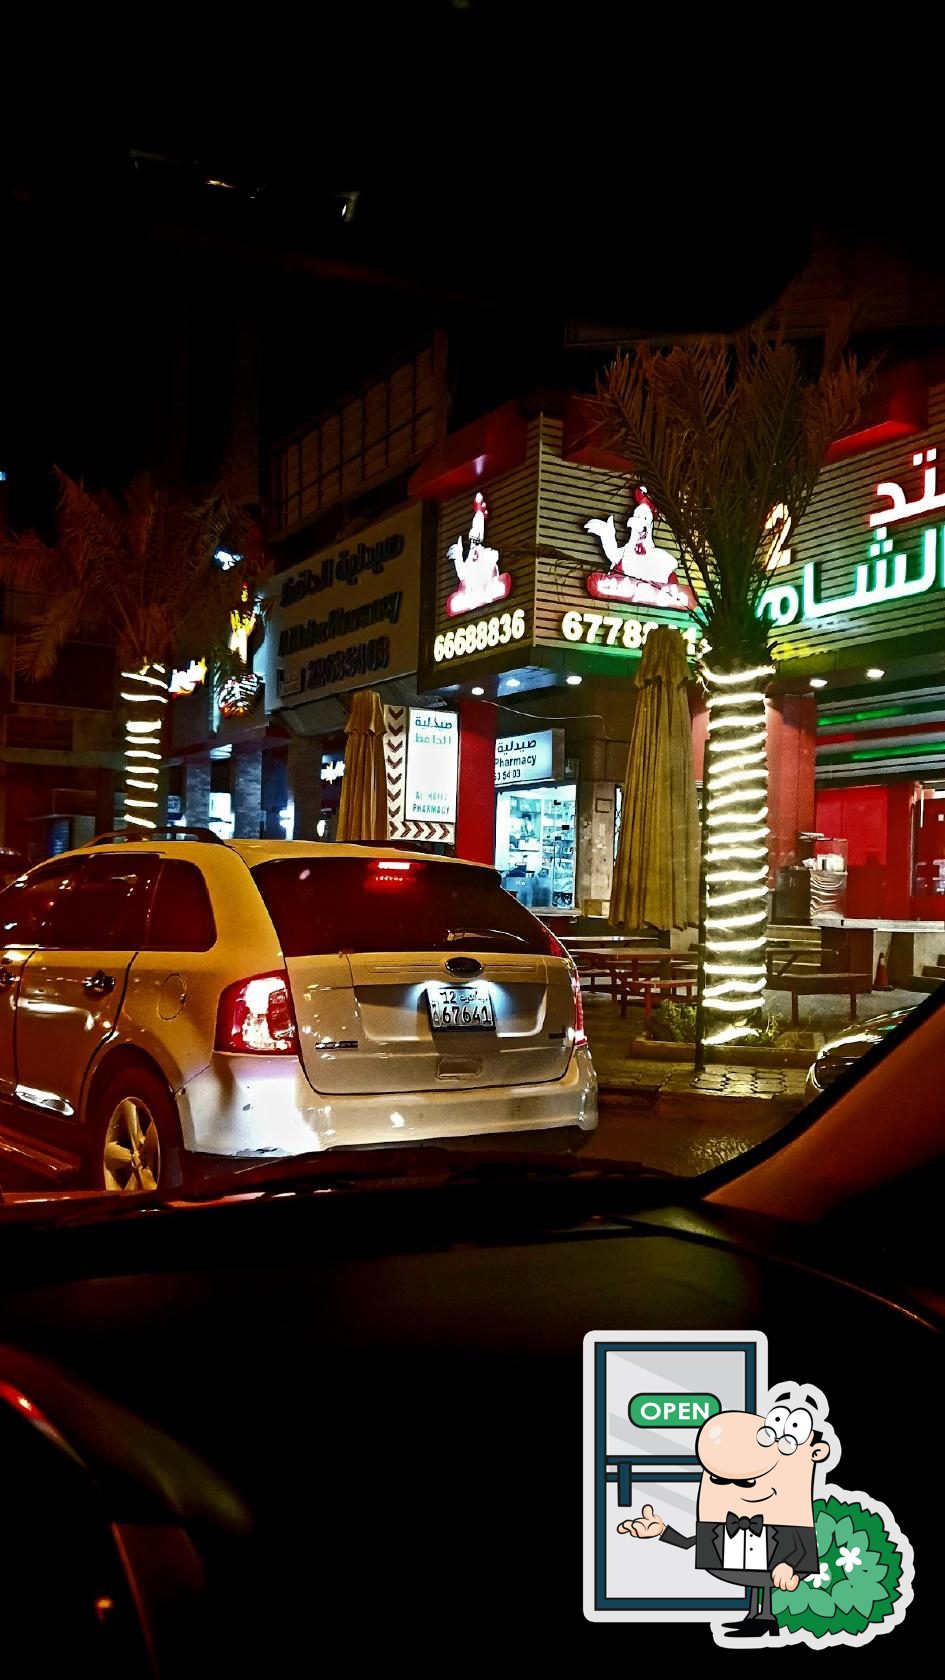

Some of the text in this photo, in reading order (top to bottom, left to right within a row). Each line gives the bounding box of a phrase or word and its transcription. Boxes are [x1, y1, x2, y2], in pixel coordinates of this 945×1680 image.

[869, 448, 945, 527] تد
[434, 609, 525, 662] 66688836
[415, 716, 452, 731] صيدلية
[497, 740, 536, 755] صيدلية
[413, 803, 450, 814] PHARMACY
[442, 1005, 491, 1023] 67641
